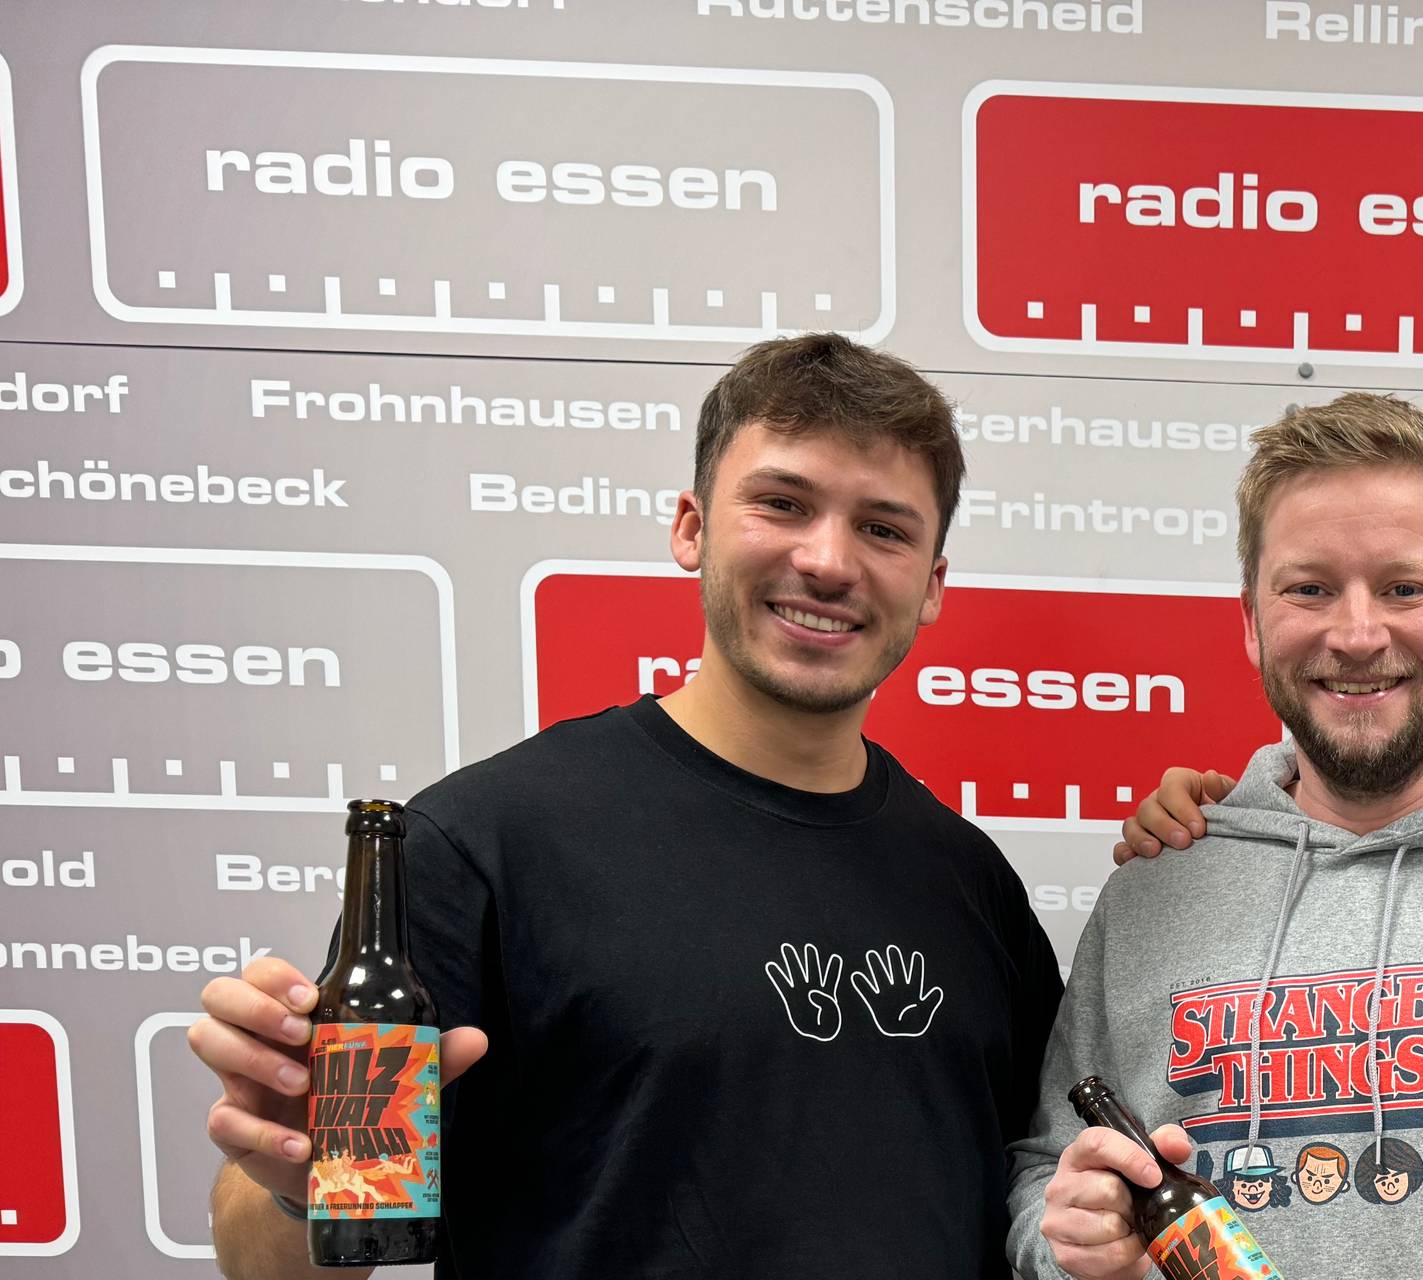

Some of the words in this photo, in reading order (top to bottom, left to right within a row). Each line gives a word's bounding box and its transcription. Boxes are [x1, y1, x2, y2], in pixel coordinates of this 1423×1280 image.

[205, 139, 455, 200] radio
[496, 157, 779, 213] essen
[1078, 173, 1319, 232] radio
[251, 379, 681, 431] Frohnhausen
[0, 459, 349, 507] chönebeck
[958, 490, 1228, 545] Frintrop
[62, 641, 341, 687] essen
[917, 665, 1185, 713] essen
[2, 850, 96, 888] old
